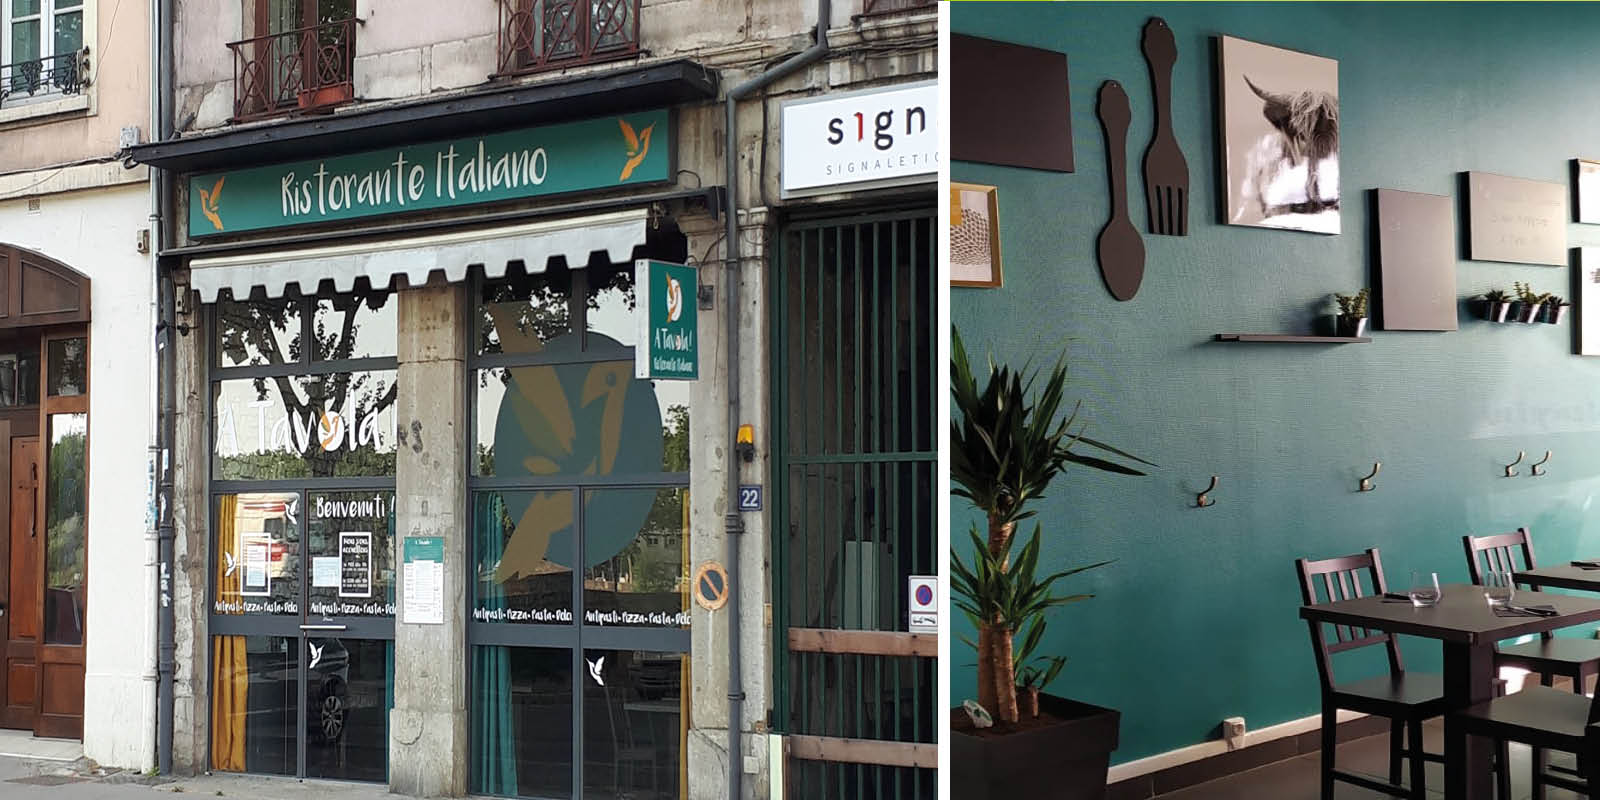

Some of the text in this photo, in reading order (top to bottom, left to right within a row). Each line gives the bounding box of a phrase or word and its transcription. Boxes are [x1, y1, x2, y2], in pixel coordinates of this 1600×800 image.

[281, 140, 548, 217] Ristorante Italiano
[214, 395, 239, 456] A
[316, 493, 385, 518] Benvenuti
[741, 489, 758, 507] 22
